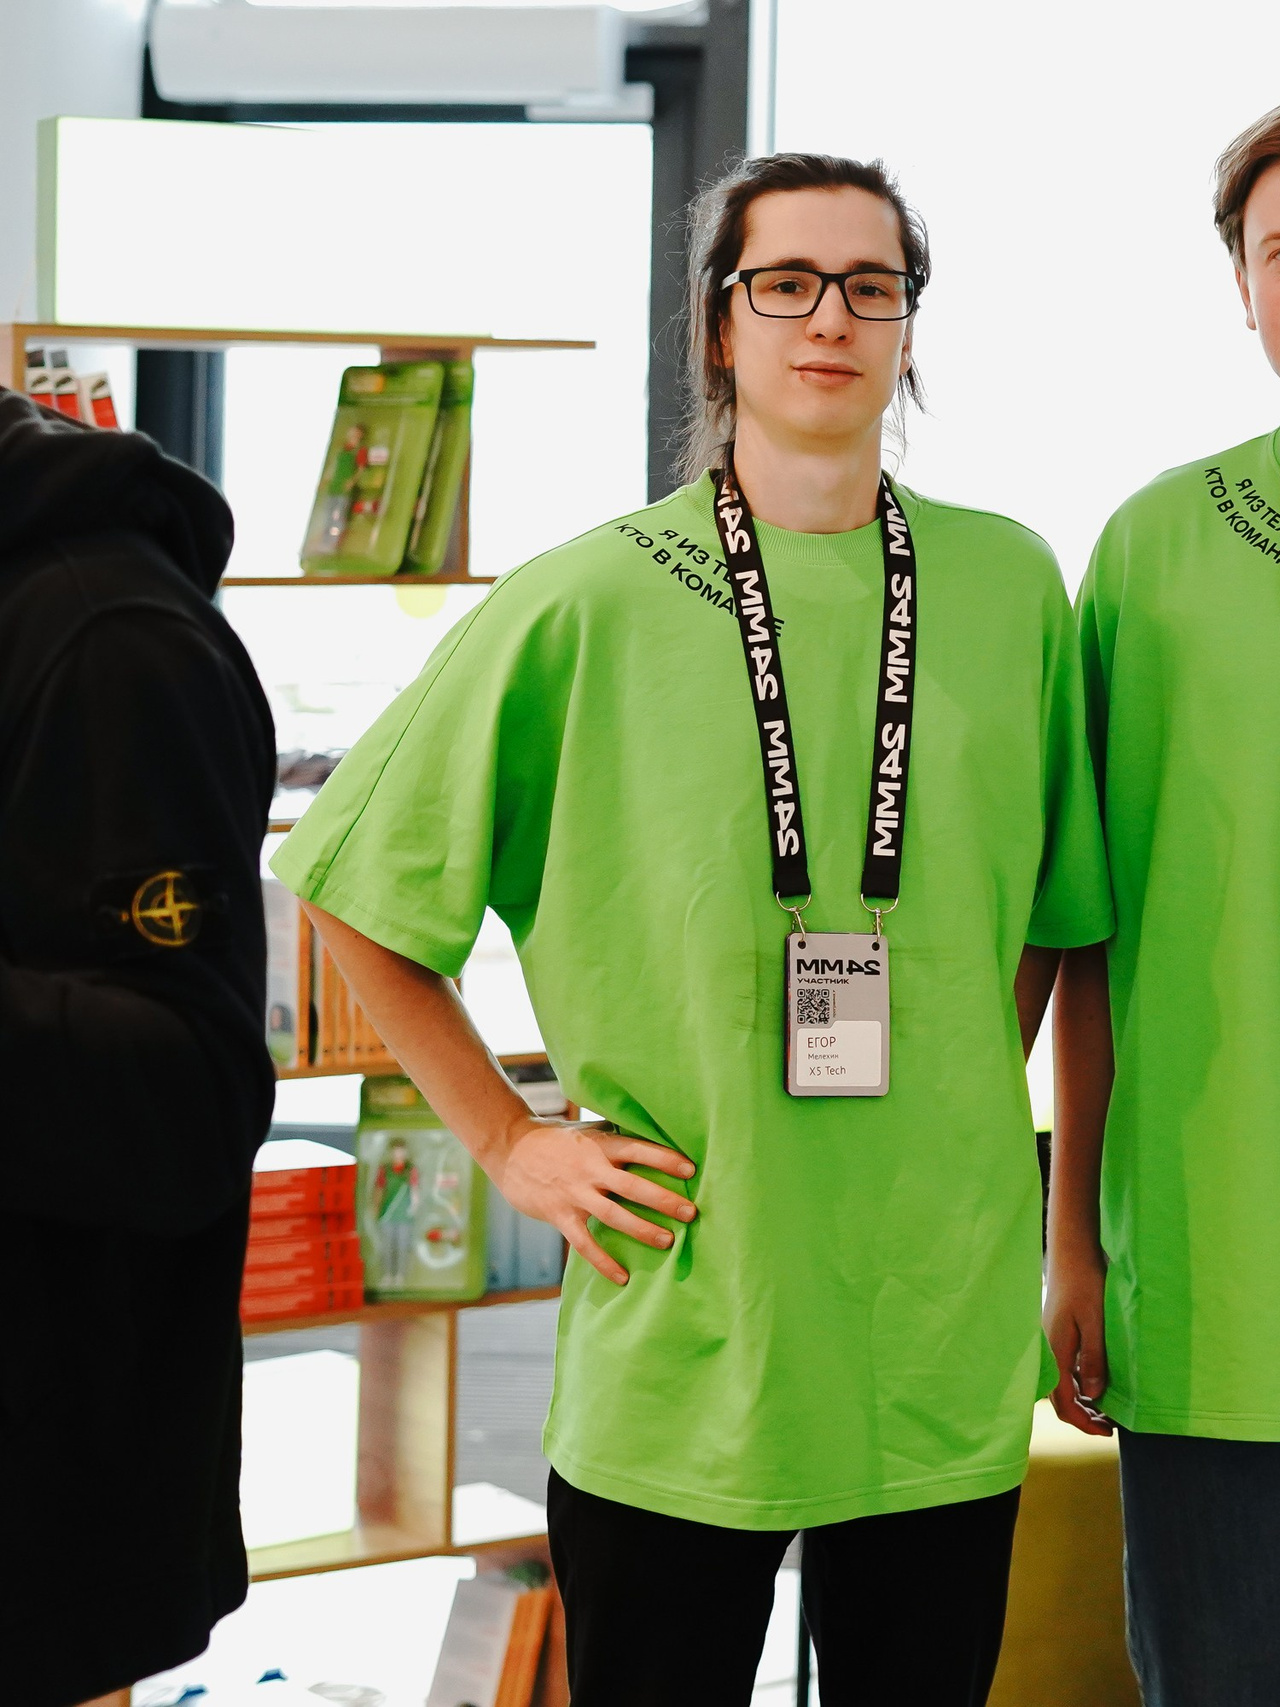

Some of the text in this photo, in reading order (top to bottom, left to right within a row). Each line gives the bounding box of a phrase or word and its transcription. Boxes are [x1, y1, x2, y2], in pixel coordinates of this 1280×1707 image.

[1204, 466, 1227, 498] КТО
[1216, 499, 1234, 513] В
[1235, 478, 1253, 492] Я
[1242, 489, 1266, 513] ИЗ
[614, 523, 654, 549] КТО
[652, 548, 672, 565] В
[658, 529, 679, 541] Я
[676, 537, 710, 565] ИЗ
[797, 977, 850, 985] УЧАСТНИК
[807, 1036, 837, 1049] ЕГОР
[825, 1065, 847, 1075] Tech
